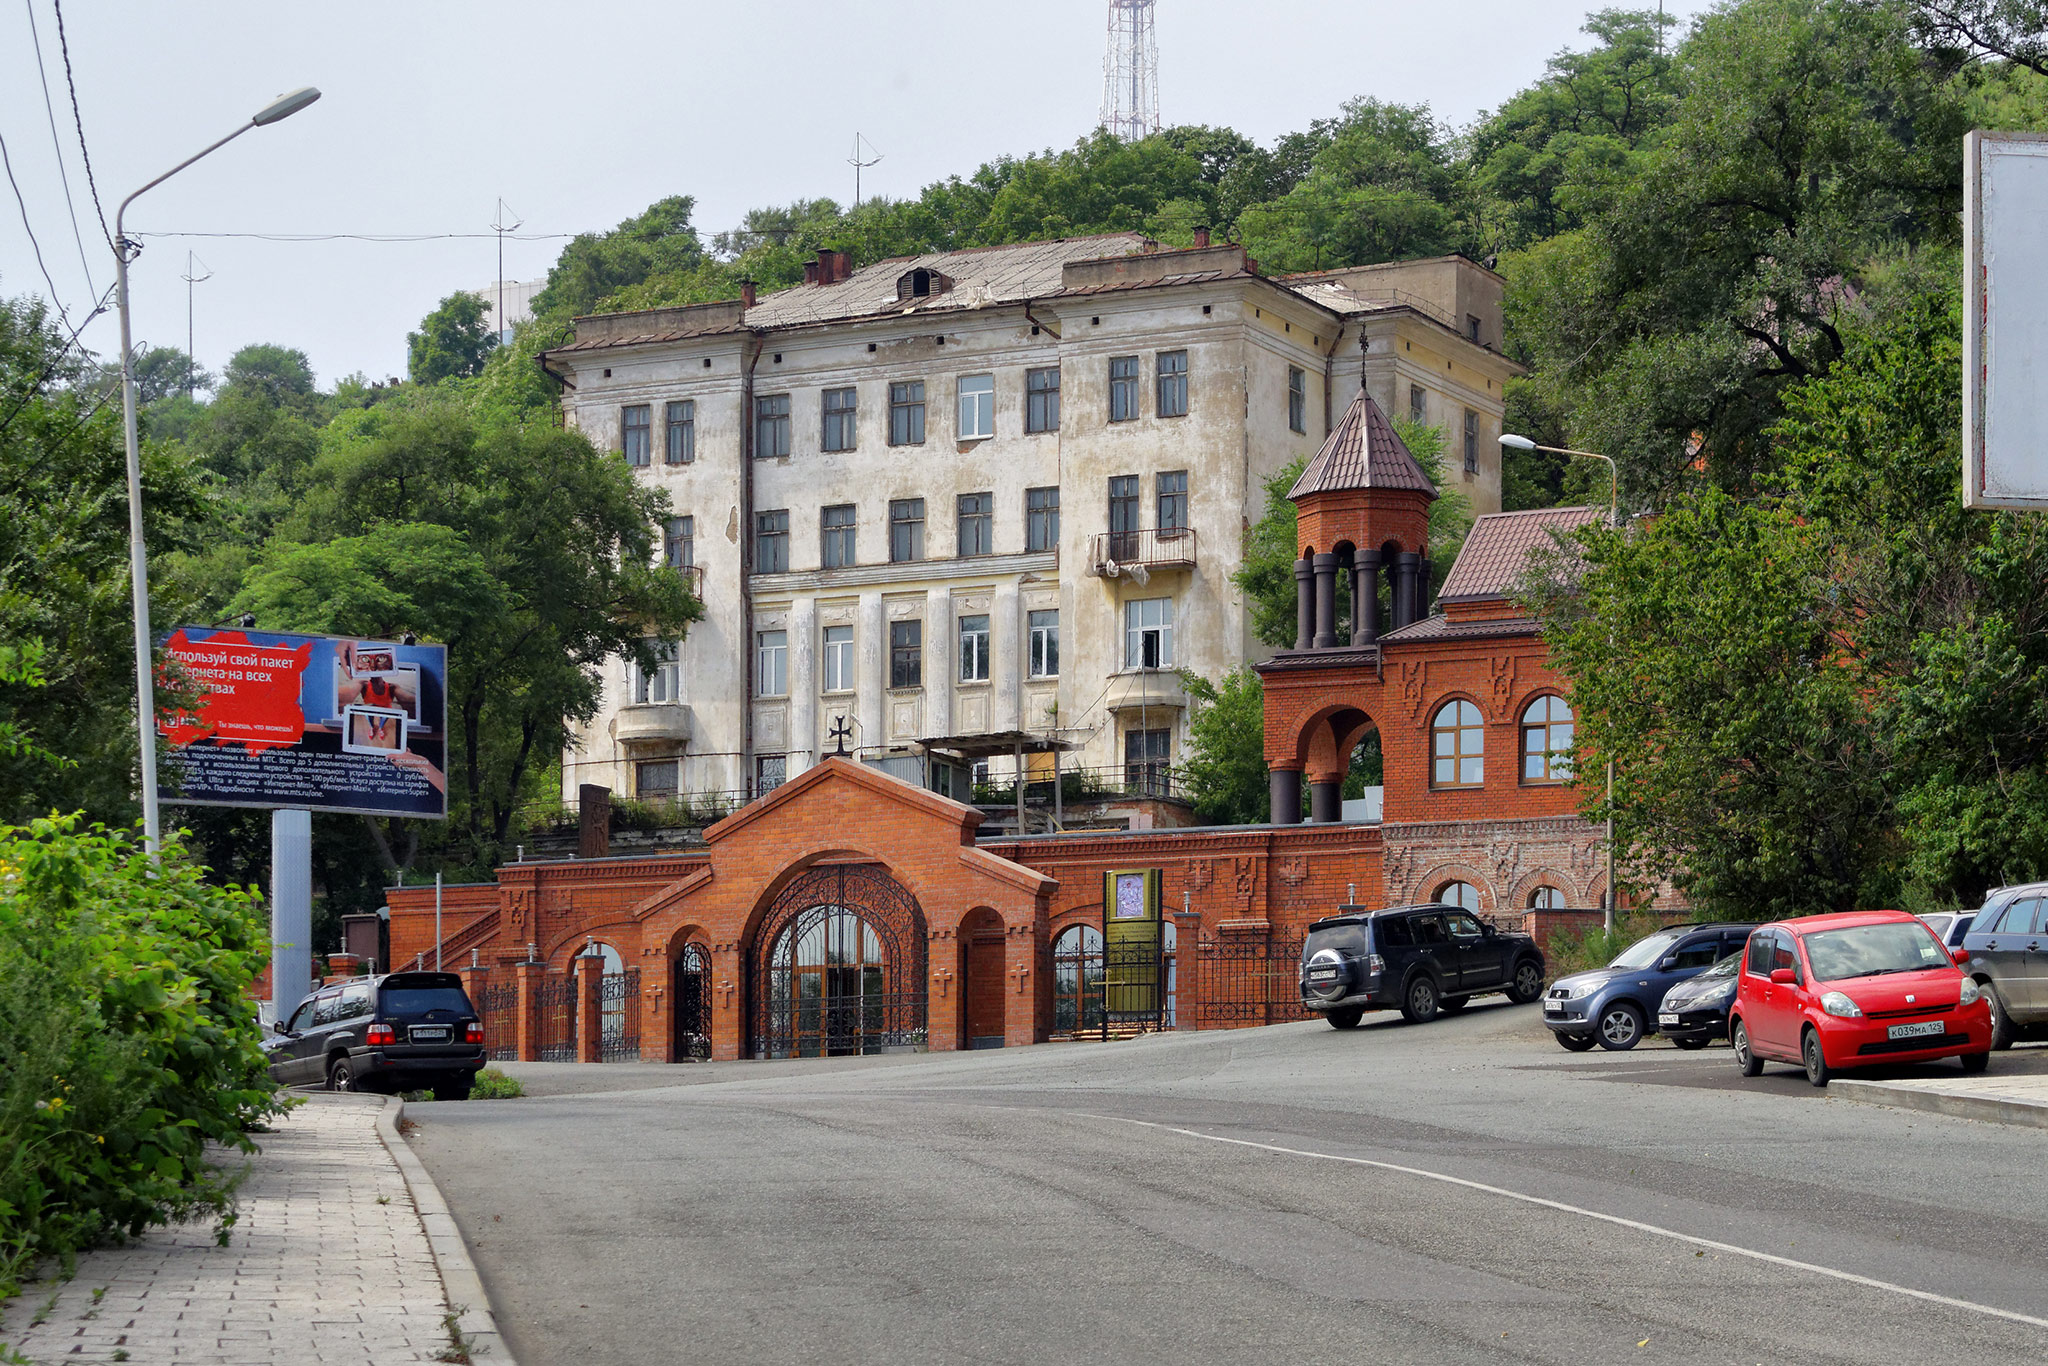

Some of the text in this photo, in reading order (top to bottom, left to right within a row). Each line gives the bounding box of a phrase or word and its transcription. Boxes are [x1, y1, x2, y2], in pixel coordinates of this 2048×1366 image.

[165, 649, 294, 669] Используй свой пакет
[229, 670, 243, 680] на
[246, 671, 272, 682] всех
[218, 721, 227, 729] Ты
[192, 753, 239, 761] подключенных
[279, 757, 296, 765] Всего
[314, 760, 364, 769] дополнительных
[206, 769, 231, 777] каждого
[232, 771, 270, 779] следующего
[270, 773, 303, 781] устройства
[350, 777, 368, 785] Услуга
[292, 767, 345, 775] дополнительного
[208, 776, 224, 784] Ultra
[214, 784, 255, 793] Подробности
[273, 789, 324, 797] www.mts.ru/one.
[1891, 1022, 1942, 1037] К039МА 125
